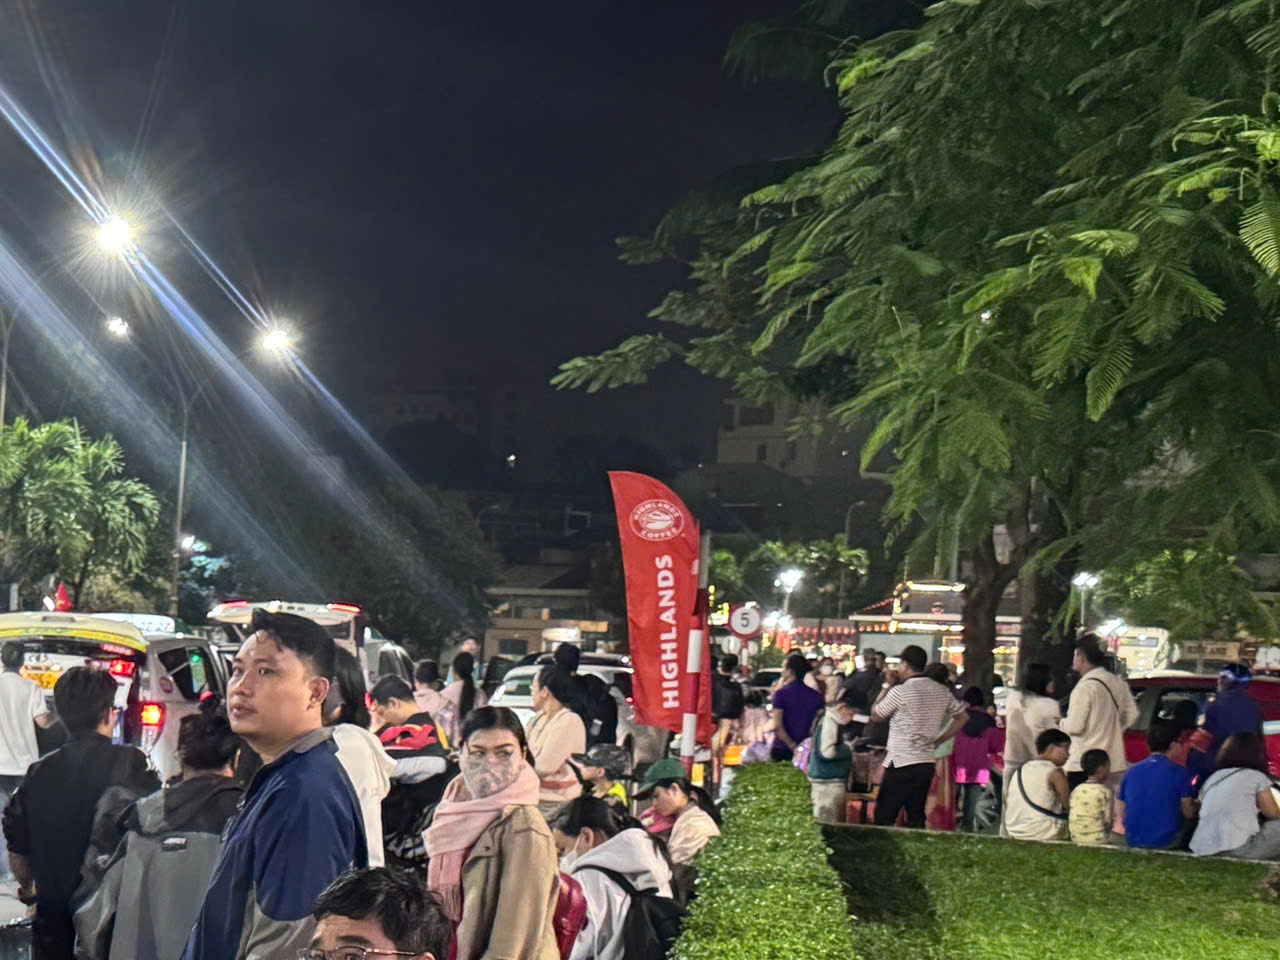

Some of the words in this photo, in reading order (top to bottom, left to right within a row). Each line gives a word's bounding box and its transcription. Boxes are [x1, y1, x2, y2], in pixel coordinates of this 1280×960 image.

[640, 527, 678, 539] COFFEE
[740, 612, 750, 628] 5
[655, 554, 680, 709] HIGHLANDS
